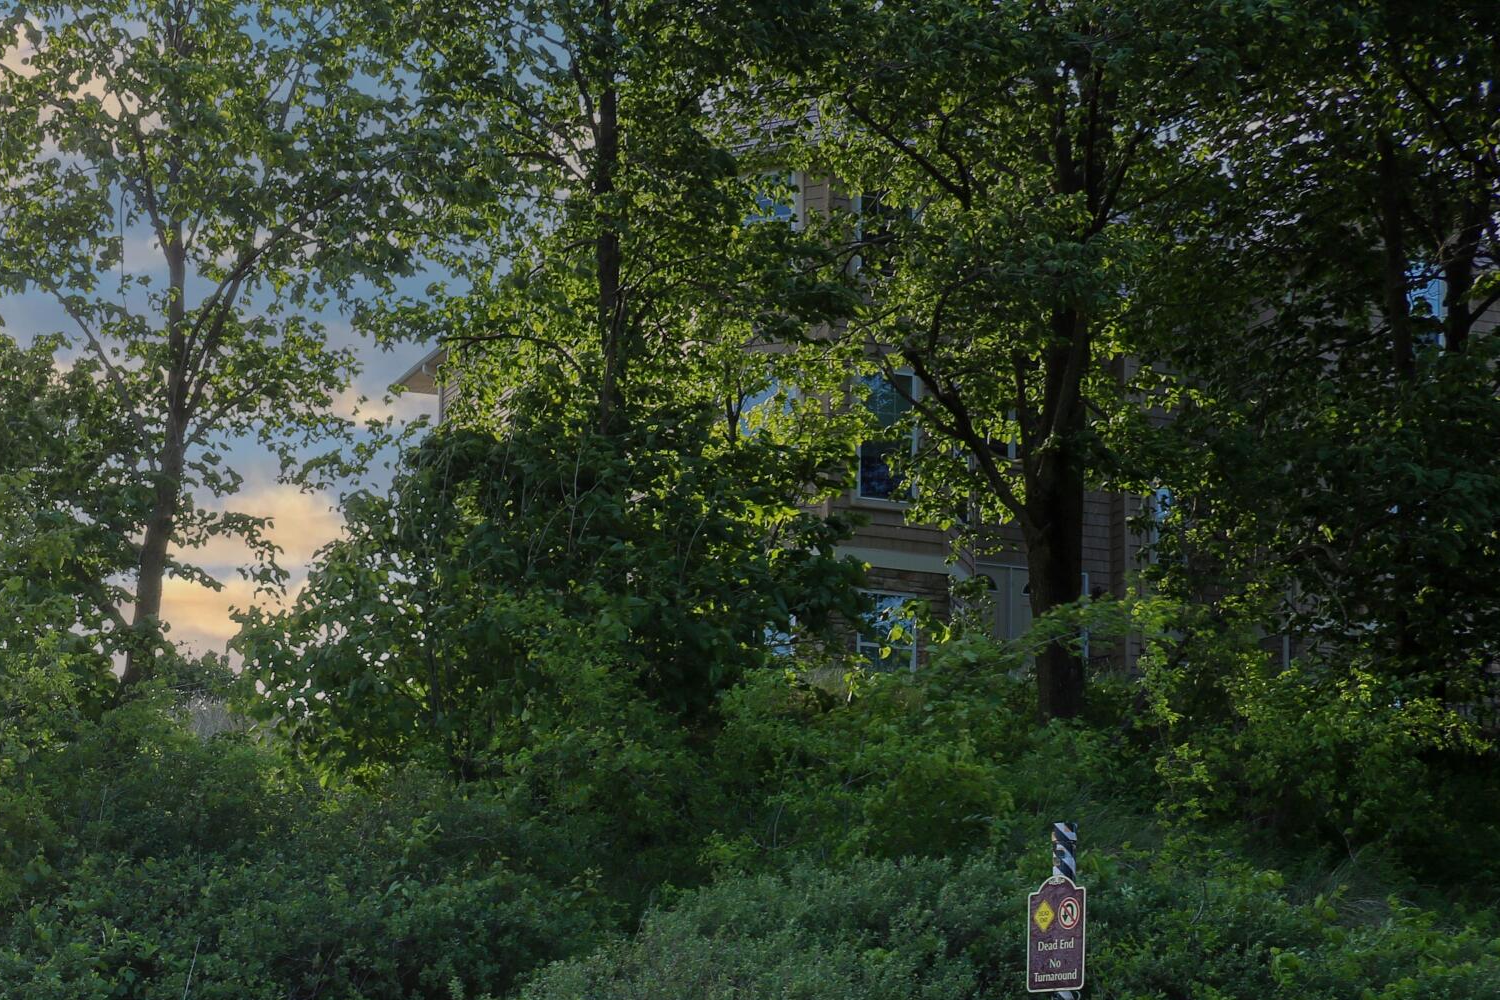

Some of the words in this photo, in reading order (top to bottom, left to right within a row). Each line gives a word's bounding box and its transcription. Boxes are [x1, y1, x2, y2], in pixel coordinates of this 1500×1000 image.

[1038, 939, 1058, 951] Dead
[1060, 937, 1074, 949] End
[1049, 958, 1061, 968] No
[1034, 968, 1077, 982] Turnaround
